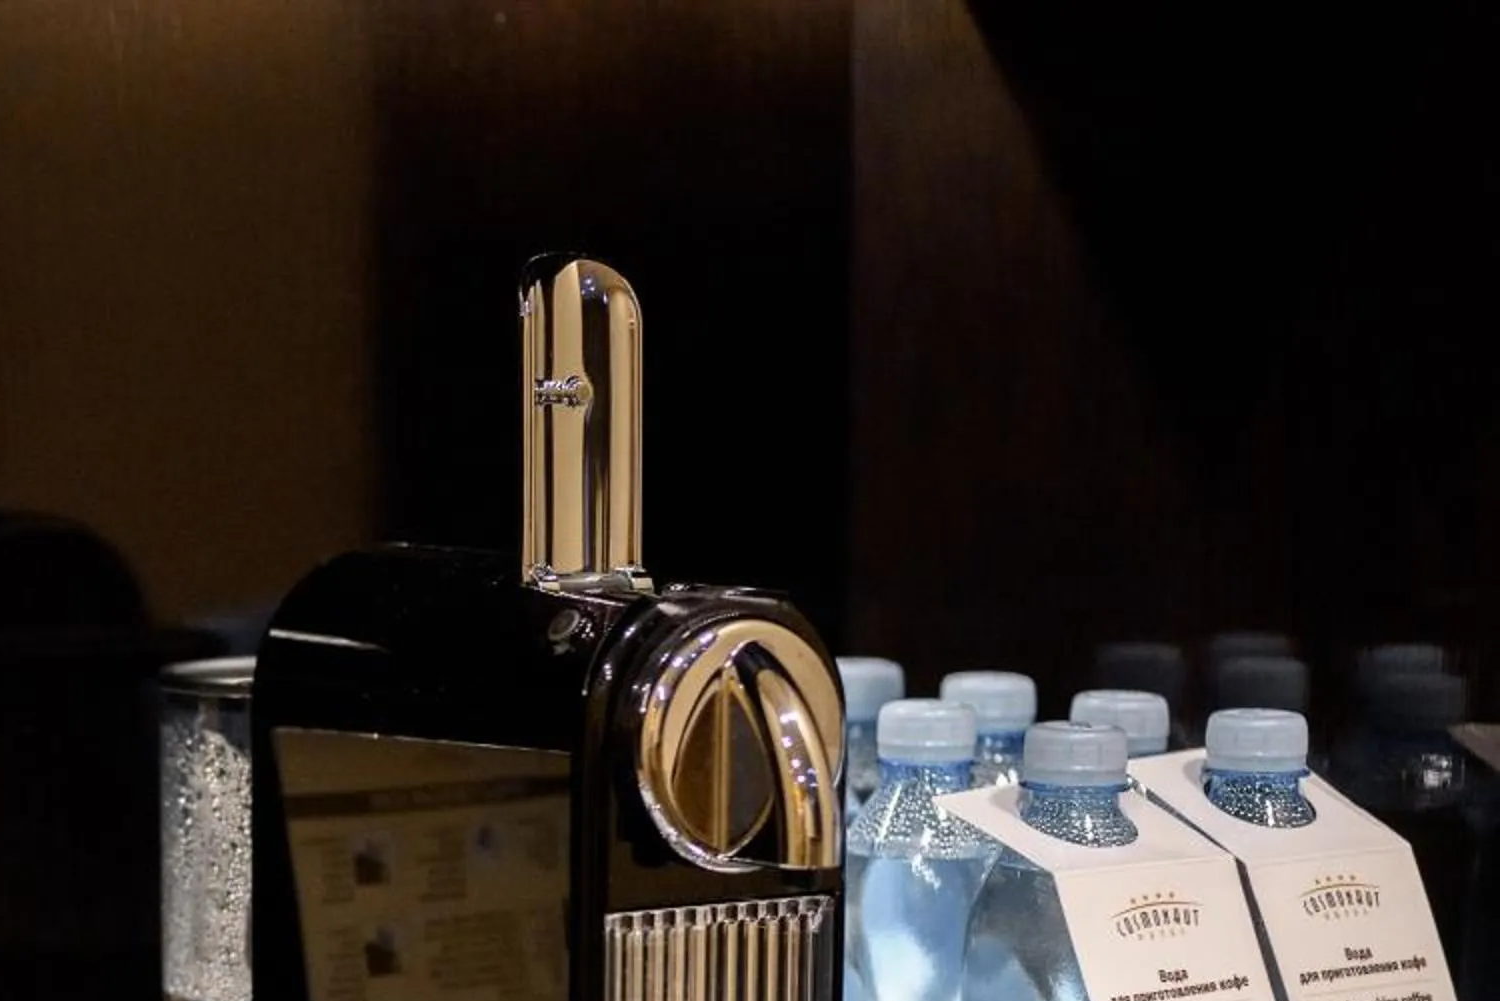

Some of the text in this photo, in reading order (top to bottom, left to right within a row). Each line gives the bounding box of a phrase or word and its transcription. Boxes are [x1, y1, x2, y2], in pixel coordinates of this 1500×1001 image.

[1344, 948, 1373, 961] Вода
[1158, 969, 1189, 983] Вода
[1299, 954, 1428, 985] для приготовления кофе
[1219, 974, 1250, 991] кофе
